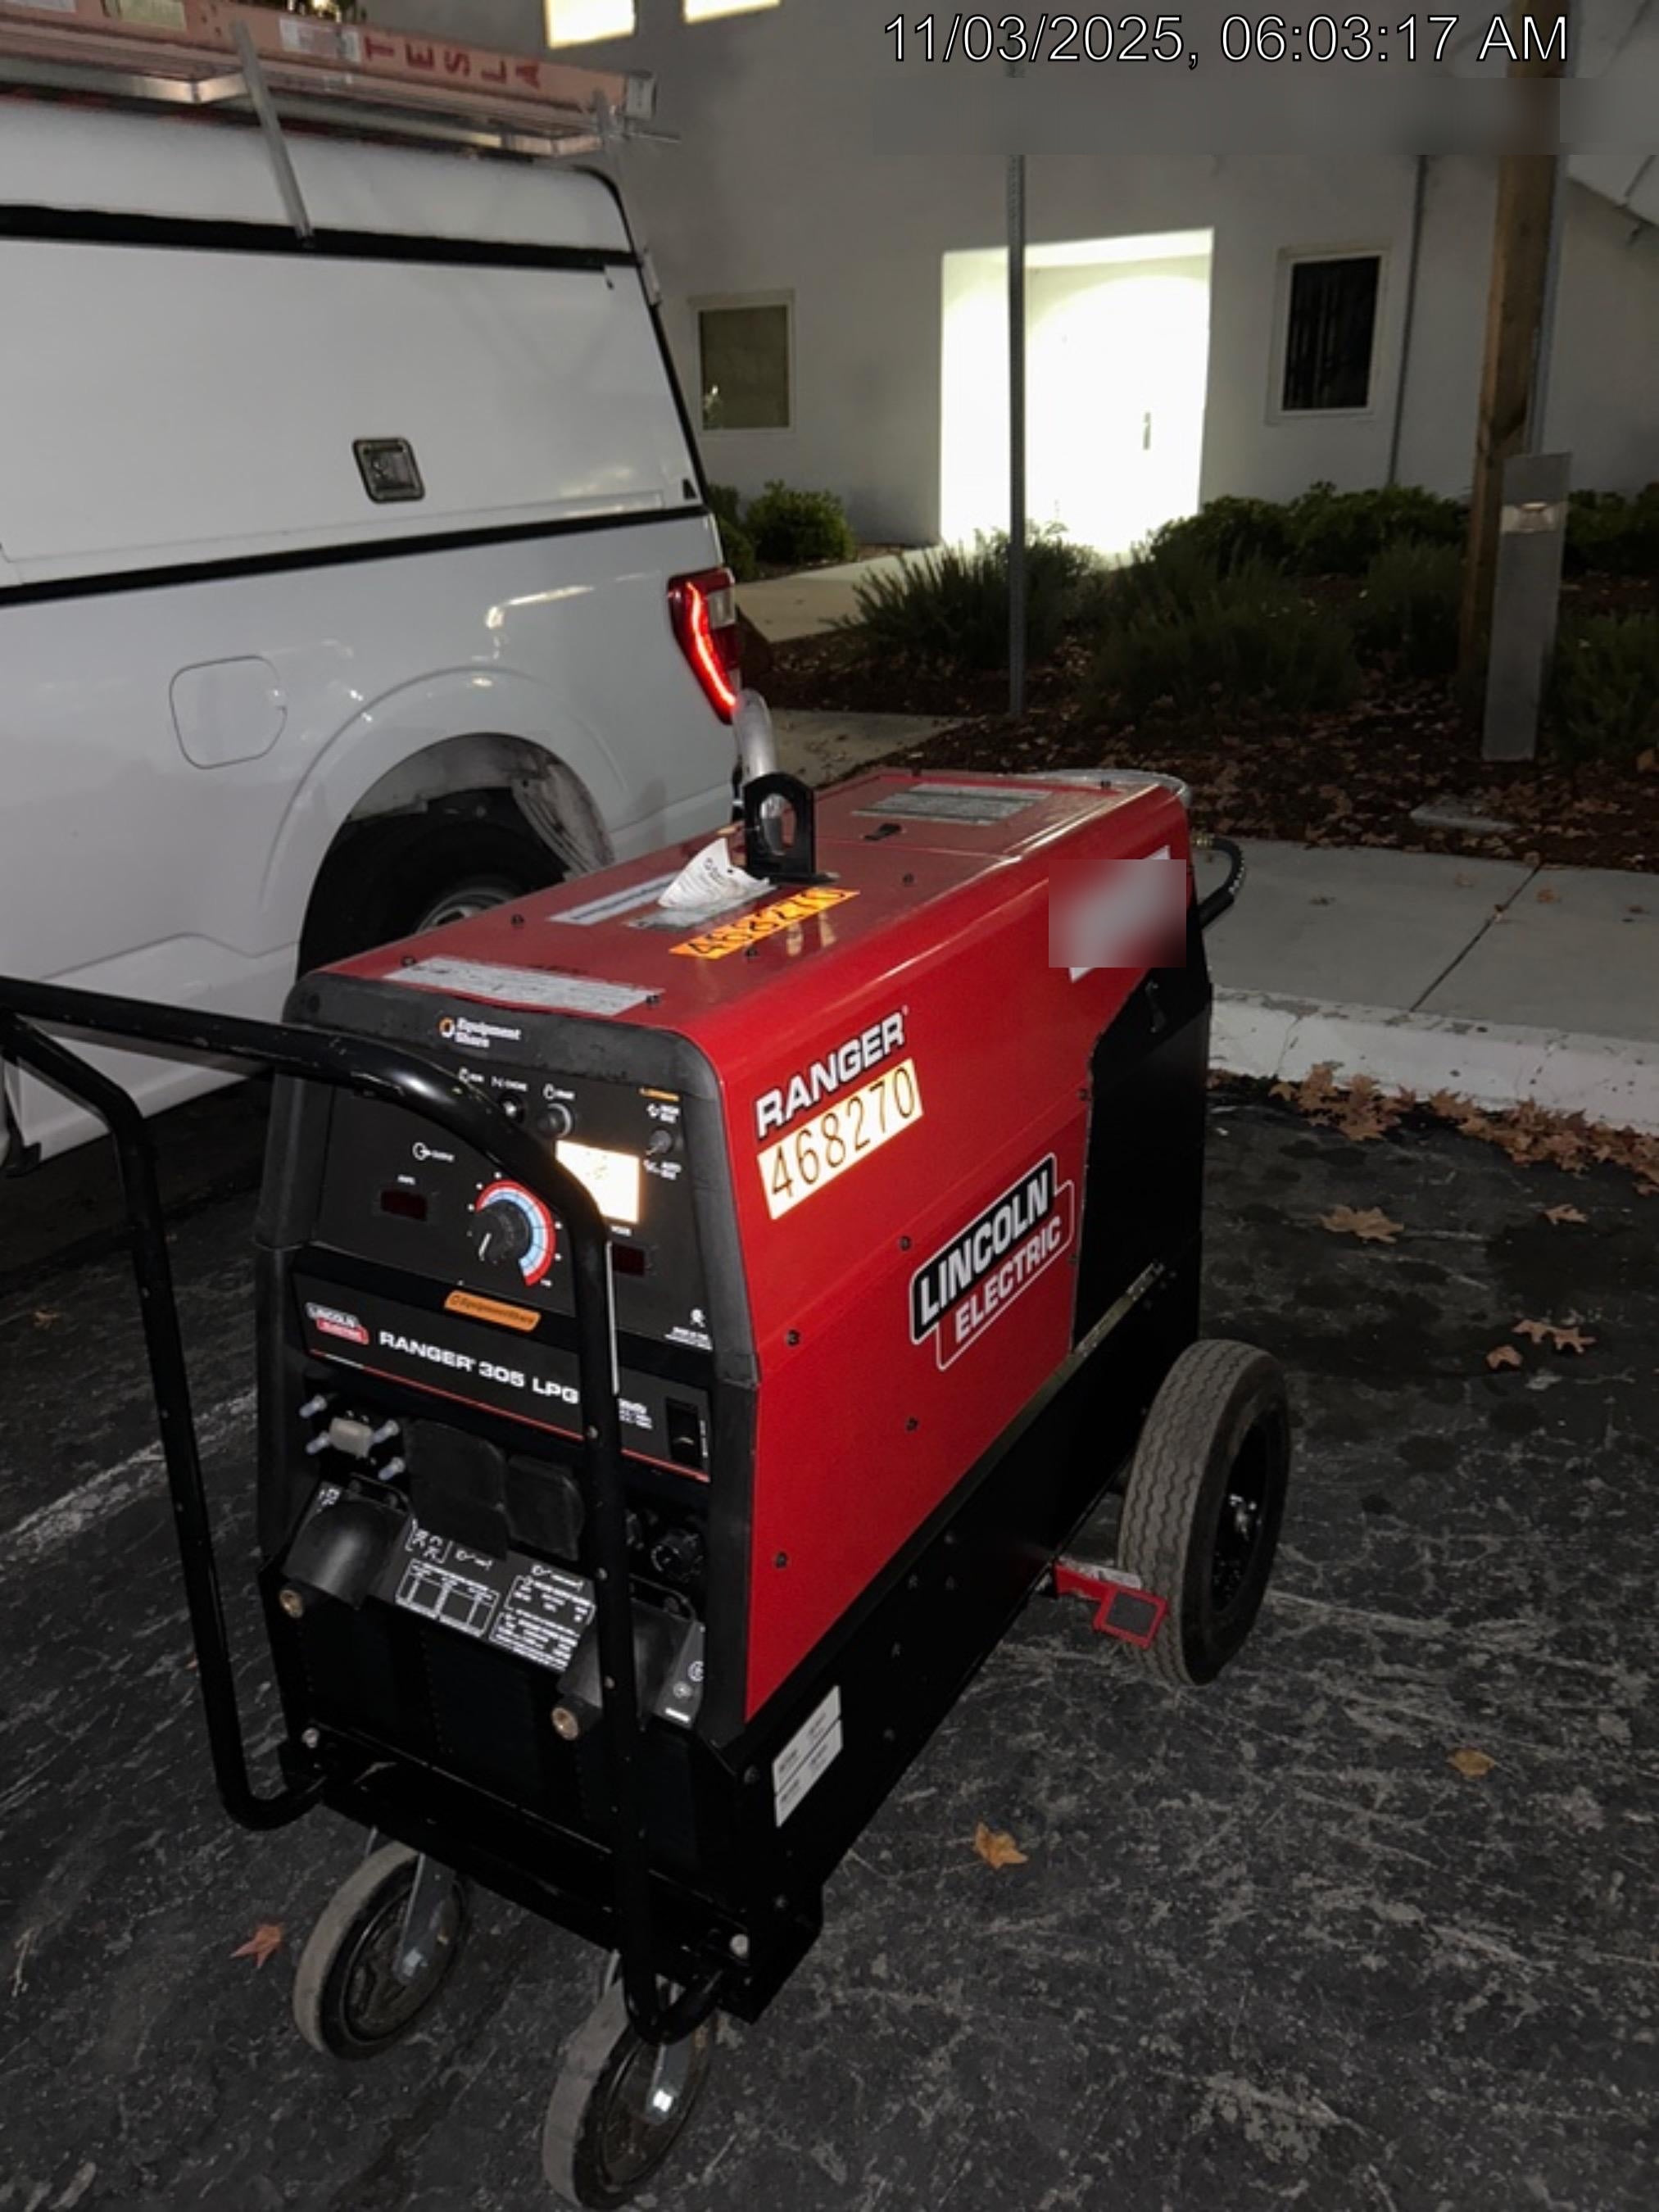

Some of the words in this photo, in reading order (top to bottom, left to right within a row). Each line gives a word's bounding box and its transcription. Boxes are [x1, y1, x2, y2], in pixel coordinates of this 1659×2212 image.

[364, 36, 541, 89] TESLA
[755, 1009, 908, 1139] RANGER
[770, 1065, 918, 1199] 468270
[918, 1170, 1049, 1327] LINCOLN
[954, 1216, 1062, 1344] ELECTRIC
[378, 1330, 475, 1372] RANGER
[478, 1360, 526, 1388] 305
[532, 1376, 579, 1405] LPG
